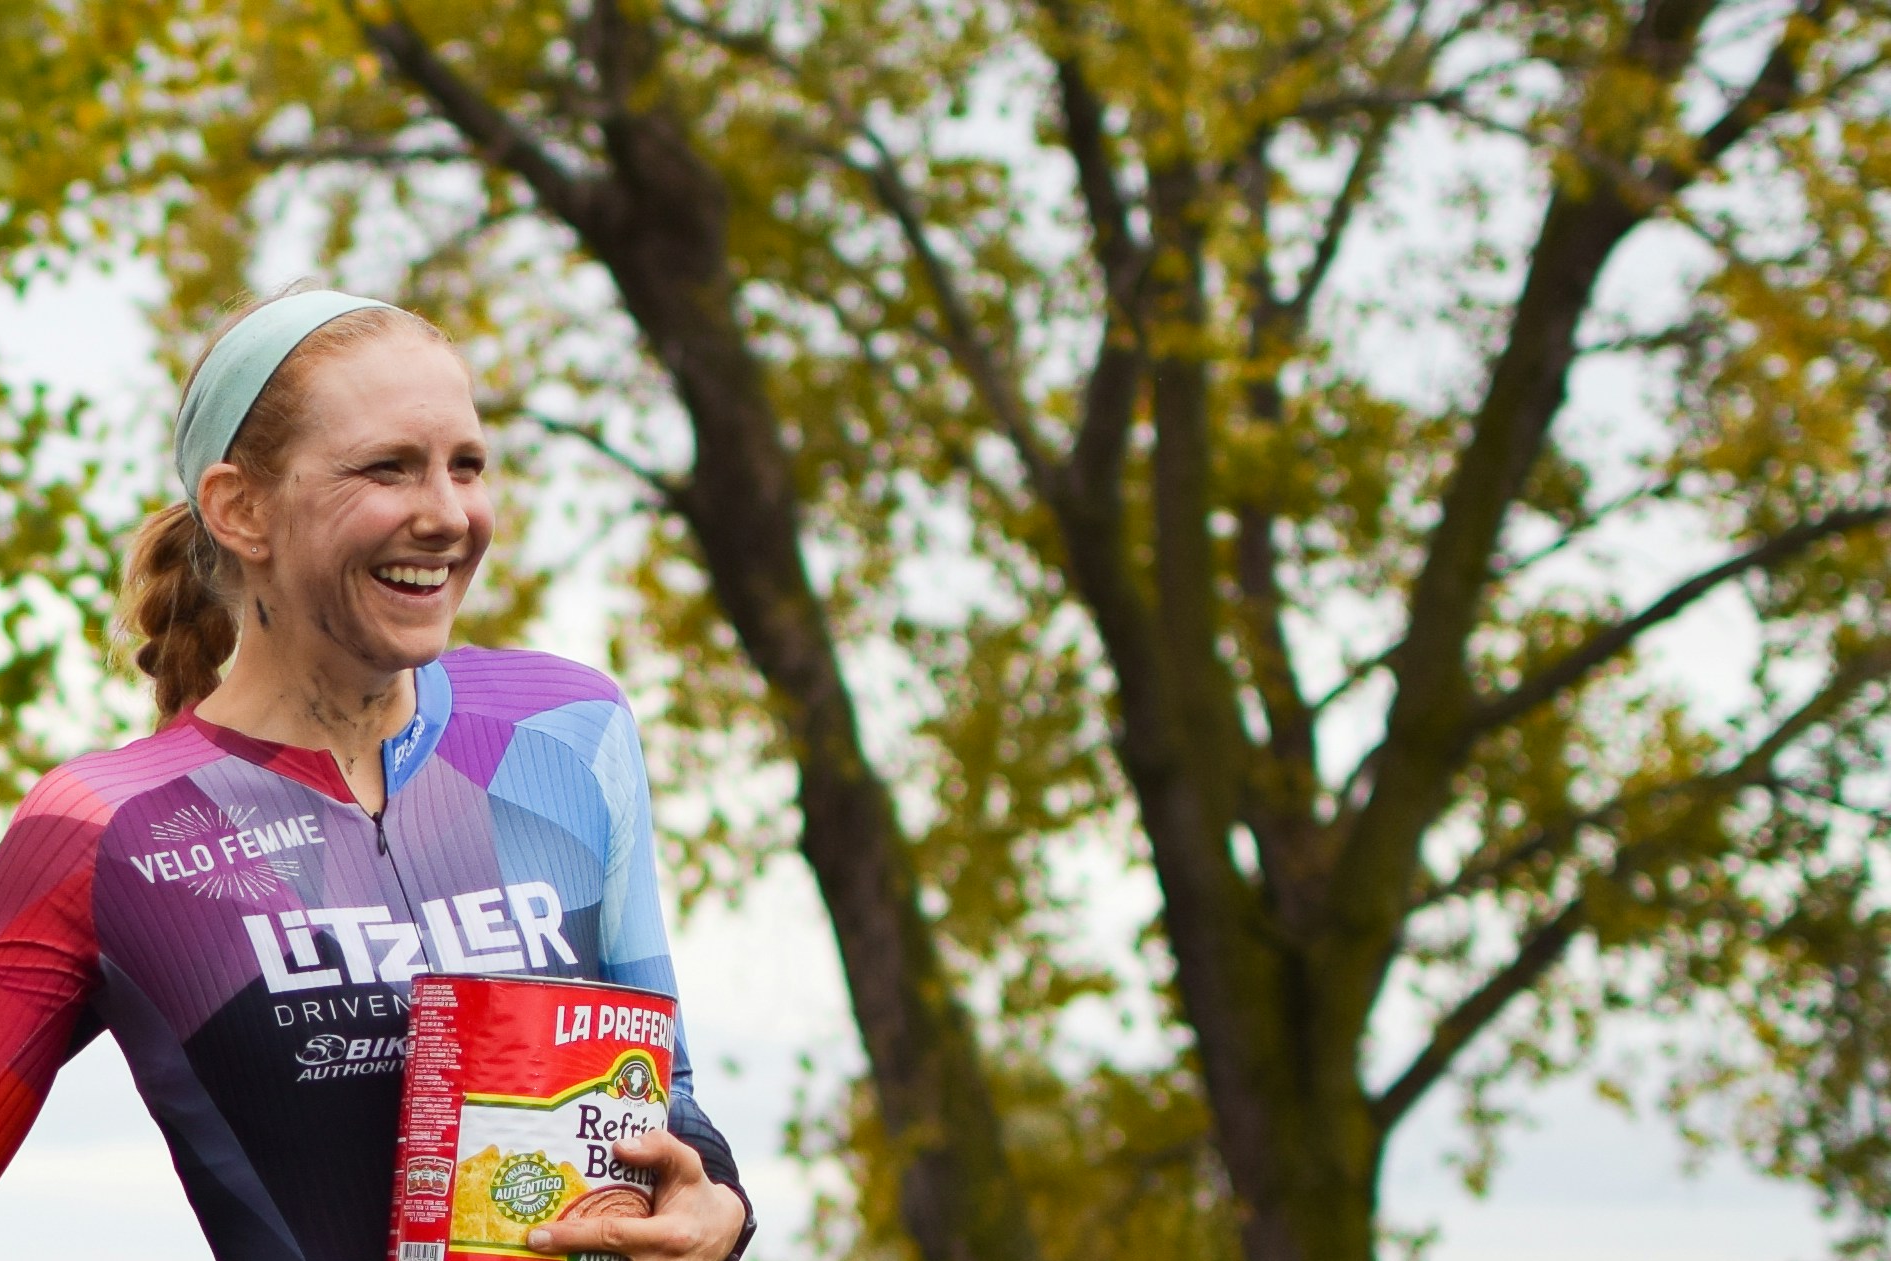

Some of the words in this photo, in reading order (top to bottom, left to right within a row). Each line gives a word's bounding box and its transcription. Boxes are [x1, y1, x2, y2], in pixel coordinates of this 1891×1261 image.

[130, 845, 216, 884] VELO
[219, 815, 326, 865] FEMME
[555, 1005, 592, 1046] LA
[576, 1104, 665, 1141] Refri
[495, 1177, 562, 1200] AUTÉNTICO
